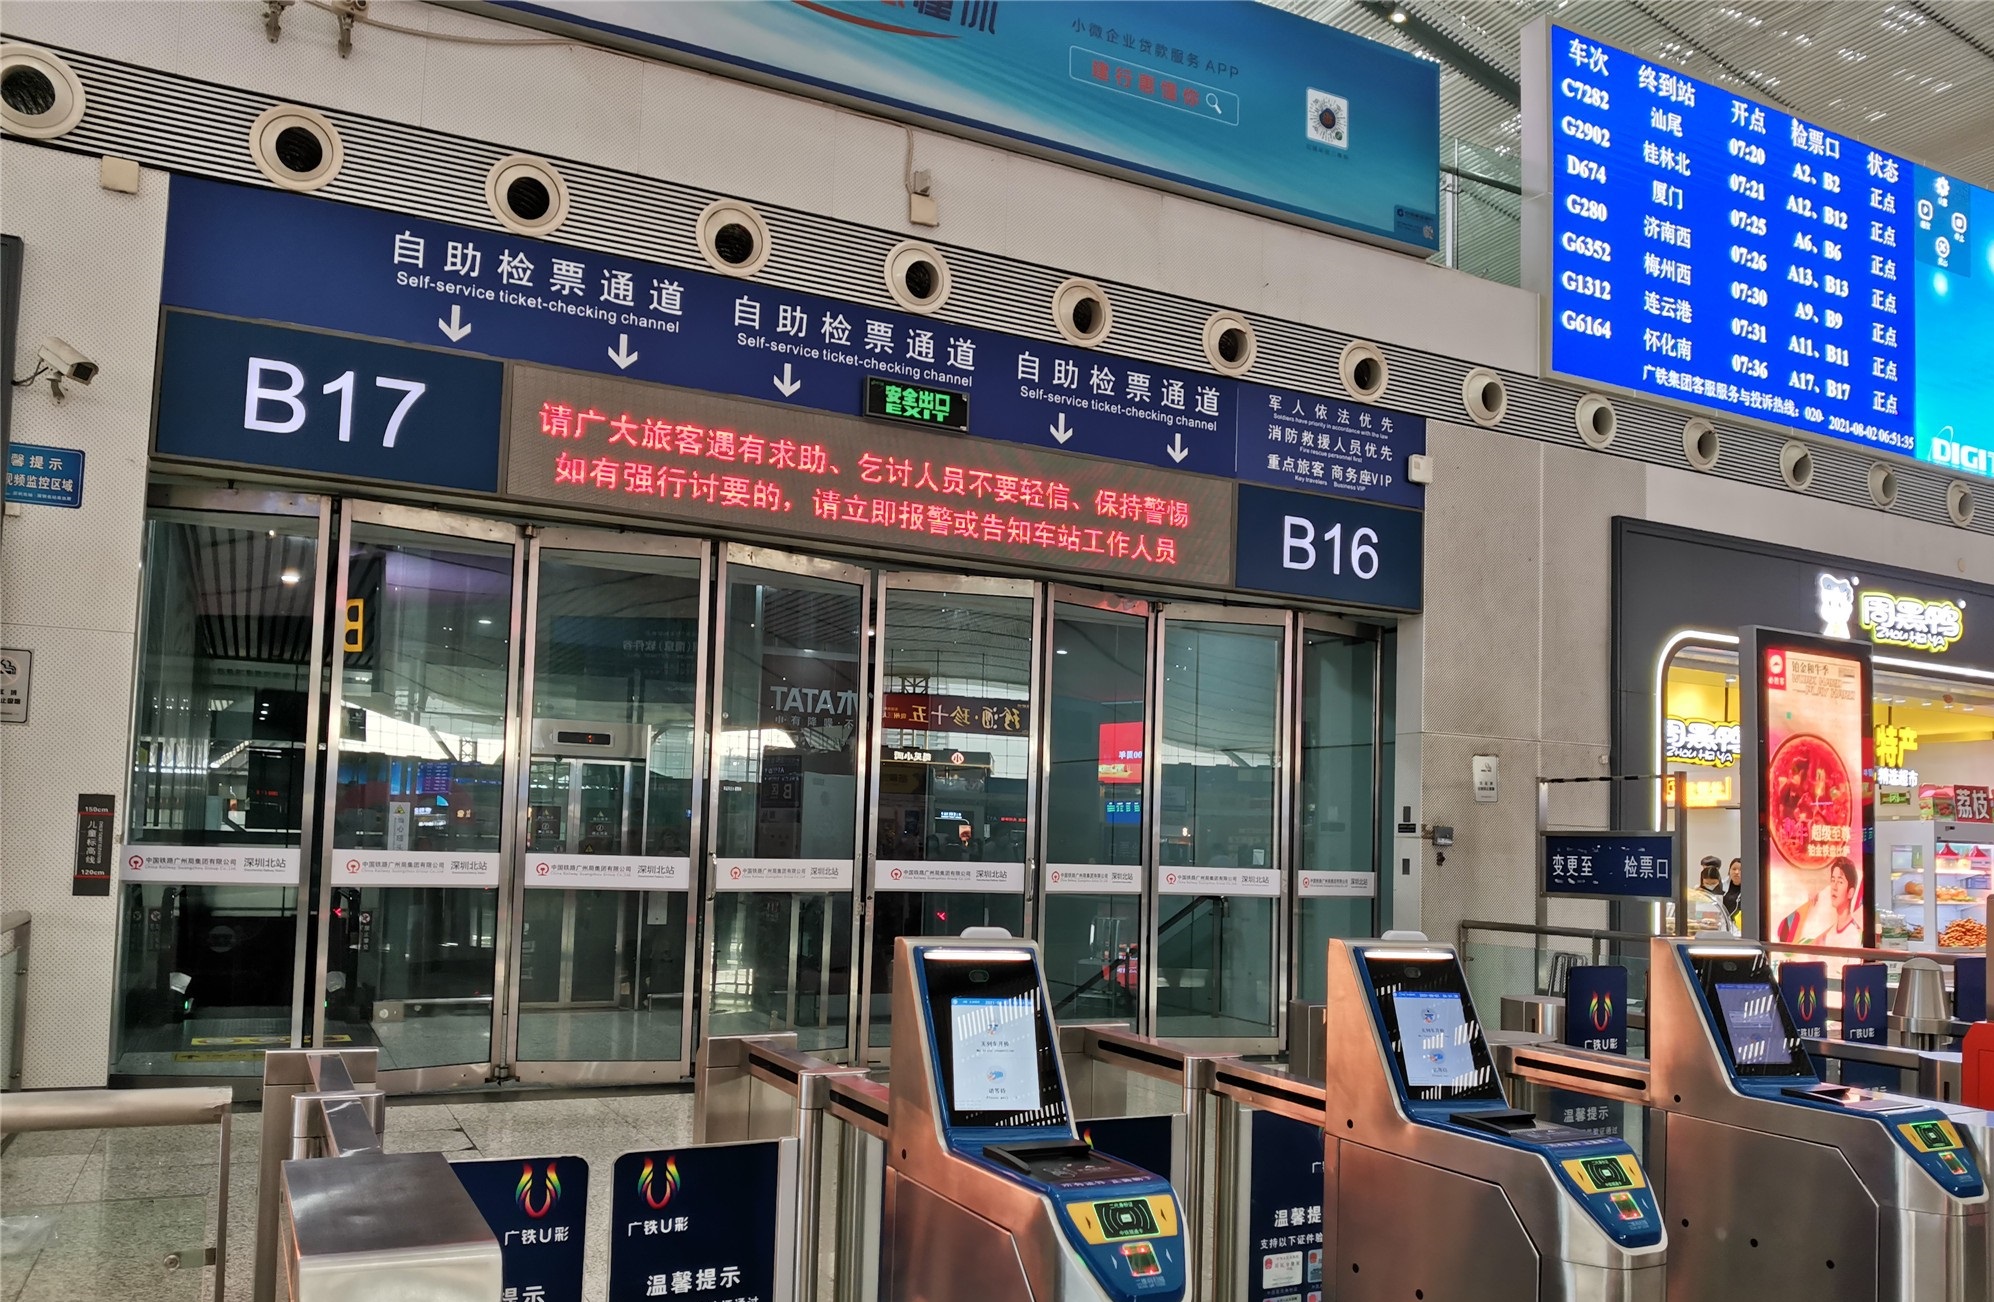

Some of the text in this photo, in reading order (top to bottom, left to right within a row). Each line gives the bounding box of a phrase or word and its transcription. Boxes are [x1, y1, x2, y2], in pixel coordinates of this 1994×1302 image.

[1071, 17, 1239, 79] 小微企业贷款服务 APP
[1568, 38, 1899, 183] 车次 终到站 开点 检票口 状态
[1561, 78, 1610, 111] C7282
[1650, 106, 1683, 138] 汕尾
[1729, 137, 1766, 166] 07:20
[1869, 187, 1896, 214] 正点
[1561, 115, 1611, 148] G2902
[1643, 140, 1691, 176] 桂林北
[1729, 173, 1766, 201] 07:21
[1870, 221, 1896, 247] 正点
[1566, 154, 1607, 184] D674
[1652, 179, 1683, 210] 厦门
[1729, 209, 1767, 236] 07:25
[1870, 255, 1896, 281] 正点
[393, 230, 685, 317] 自助检票通道
[1566, 194, 1608, 222] G280
[1644, 214, 1691, 249] 济南西
[1730, 245, 1768, 272] 07:26
[1871, 289, 1897, 314] 正点
[396, 270, 680, 333] Self-service ticket-checking channel
[1562, 231, 1611, 262] G6352
[1644, 252, 1692, 286] 梅州西
[1730, 281, 1768, 307] 07:30
[1871, 322, 1898, 348] 正点
[734, 295, 976, 371] 自助检票通道
[1562, 271, 1611, 300] G1312
[1644, 290, 1692, 324] 连云港
[1731, 317, 1767, 343] 07:31
[1872, 356, 1898, 382] 正点
[737, 333, 973, 387] Self-service ticket-checking channel
[1562, 310, 1612, 339] G6164
[1643, 327, 1692, 362] 怀化南
[1731, 354, 1768, 379] 07:36
[1872, 391, 1898, 415] 正点
[244, 356, 426, 448] B17
[885, 385, 951, 412] 安全出口
[1017, 351, 1220, 416] 自助检票通道
[885, 402, 950, 423] EXIT
[1020, 386, 1217, 432] Self-service ticket-checking channel
[1268, 394, 1394, 433] 军人依法优先
[1268, 424, 1393, 461] 消防救援人员优先
[1828, 416, 1878, 440] 2021-08-02
[1878, 428, 1914, 450] 06:51:35
[1267, 453, 1392, 487] 重点旅客 商务座VIP
[1283, 515, 1379, 580] B16
[1863, 595, 1960, 637] 周黑鸭
[1876, 724, 1918, 768] 特产
[1956, 788, 1990, 820] 荔枝
[243, 857, 286, 868] 深圳北站
[450, 860, 487, 871] 深圳北站
[637, 864, 675, 875] 深圳北站
[976, 869, 1007, 878] 深圳北站
[1552, 854, 1669, 879] 变更至 检票口
[1584, 1038, 1618, 1050] 广铁U彩
[1849, 1027, 1875, 1039] 广铁U彩
[1563, 1105, 1609, 1123] 温馨提示
[504, 1226, 570, 1246] 广铁U彩
[627, 1216, 689, 1237] 广铁U彩
[646, 1266, 741, 1297] 温馨提示
